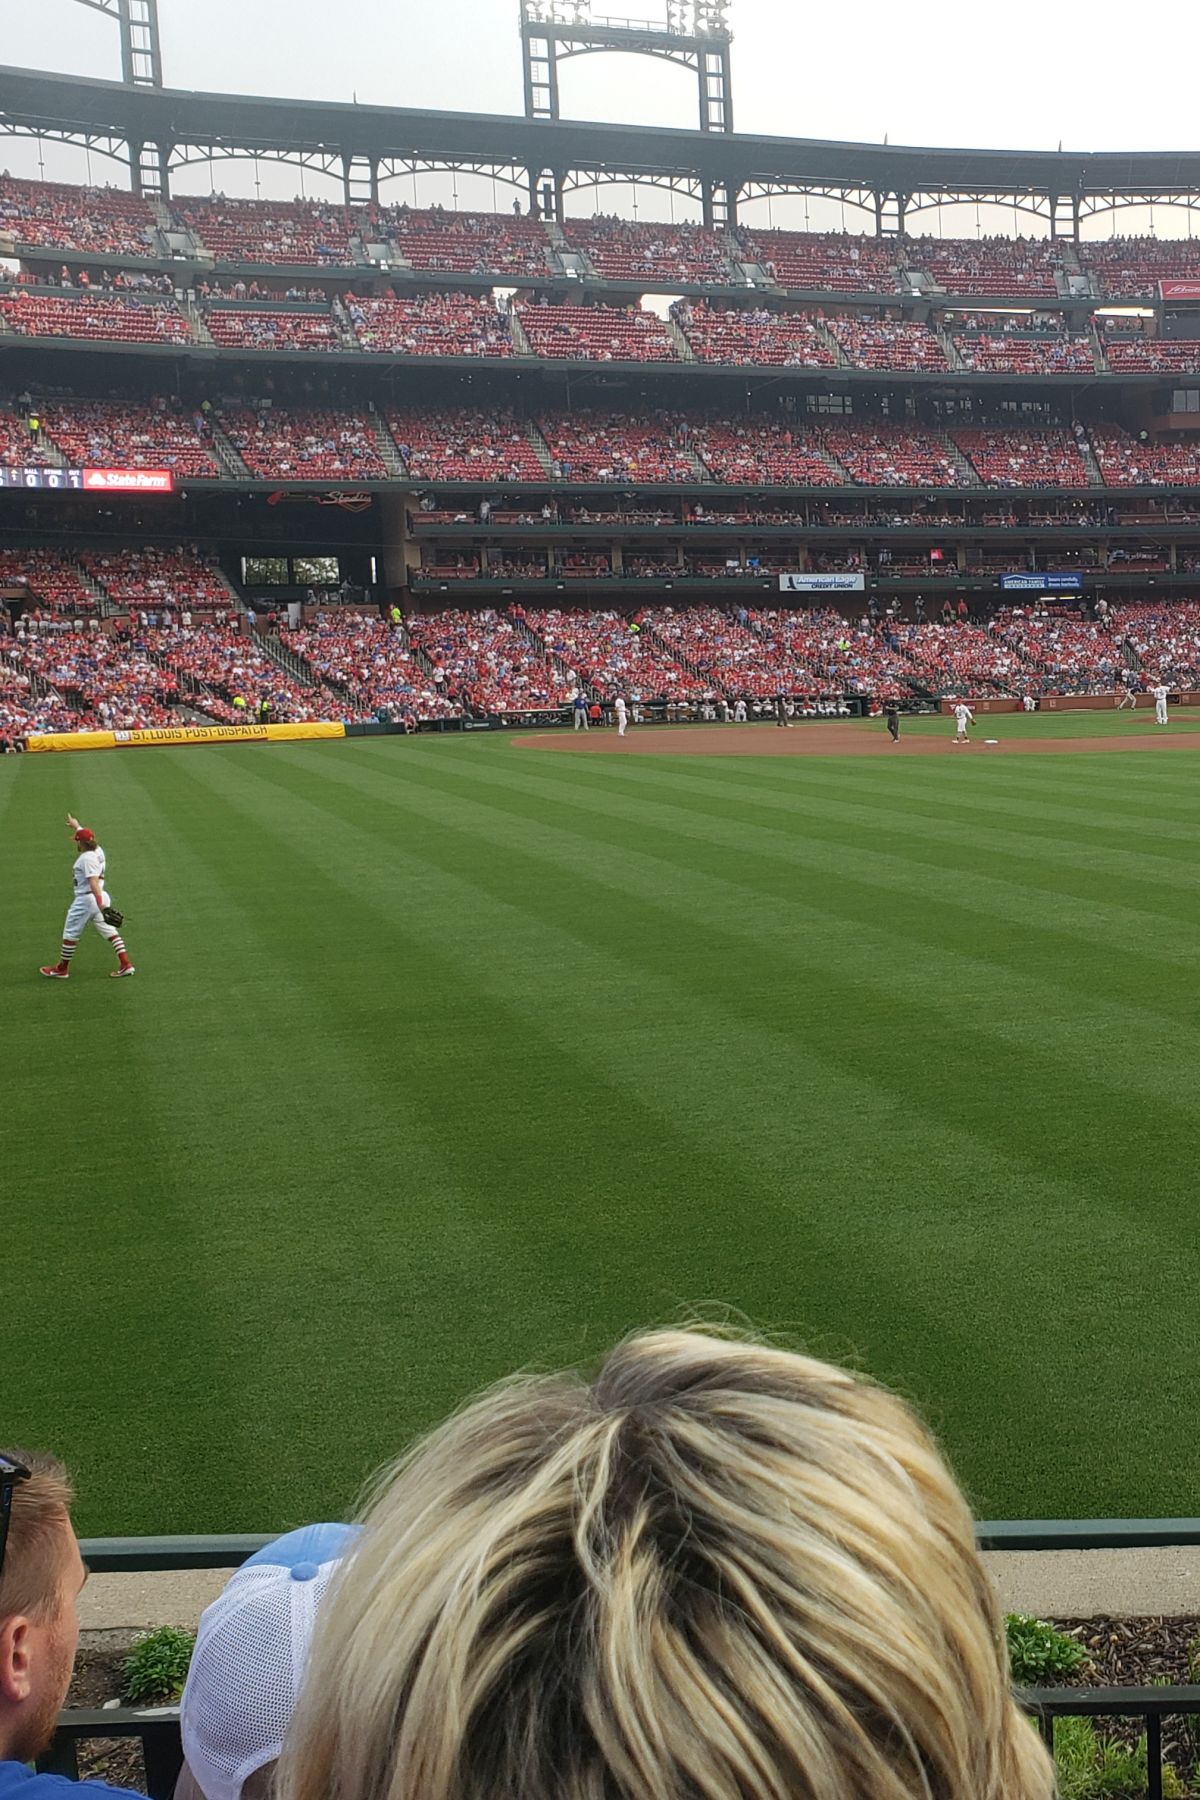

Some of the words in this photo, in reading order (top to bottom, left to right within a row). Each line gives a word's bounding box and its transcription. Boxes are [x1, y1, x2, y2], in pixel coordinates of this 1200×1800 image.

[26, 474, 37, 487] 0
[48, 475, 59, 488] 0
[70, 476, 79, 488] 1
[132, 731, 150, 740] ST.
[151, 730, 182, 739] LOUIS
[186, 725, 268, 738] POST-DISPATCH
